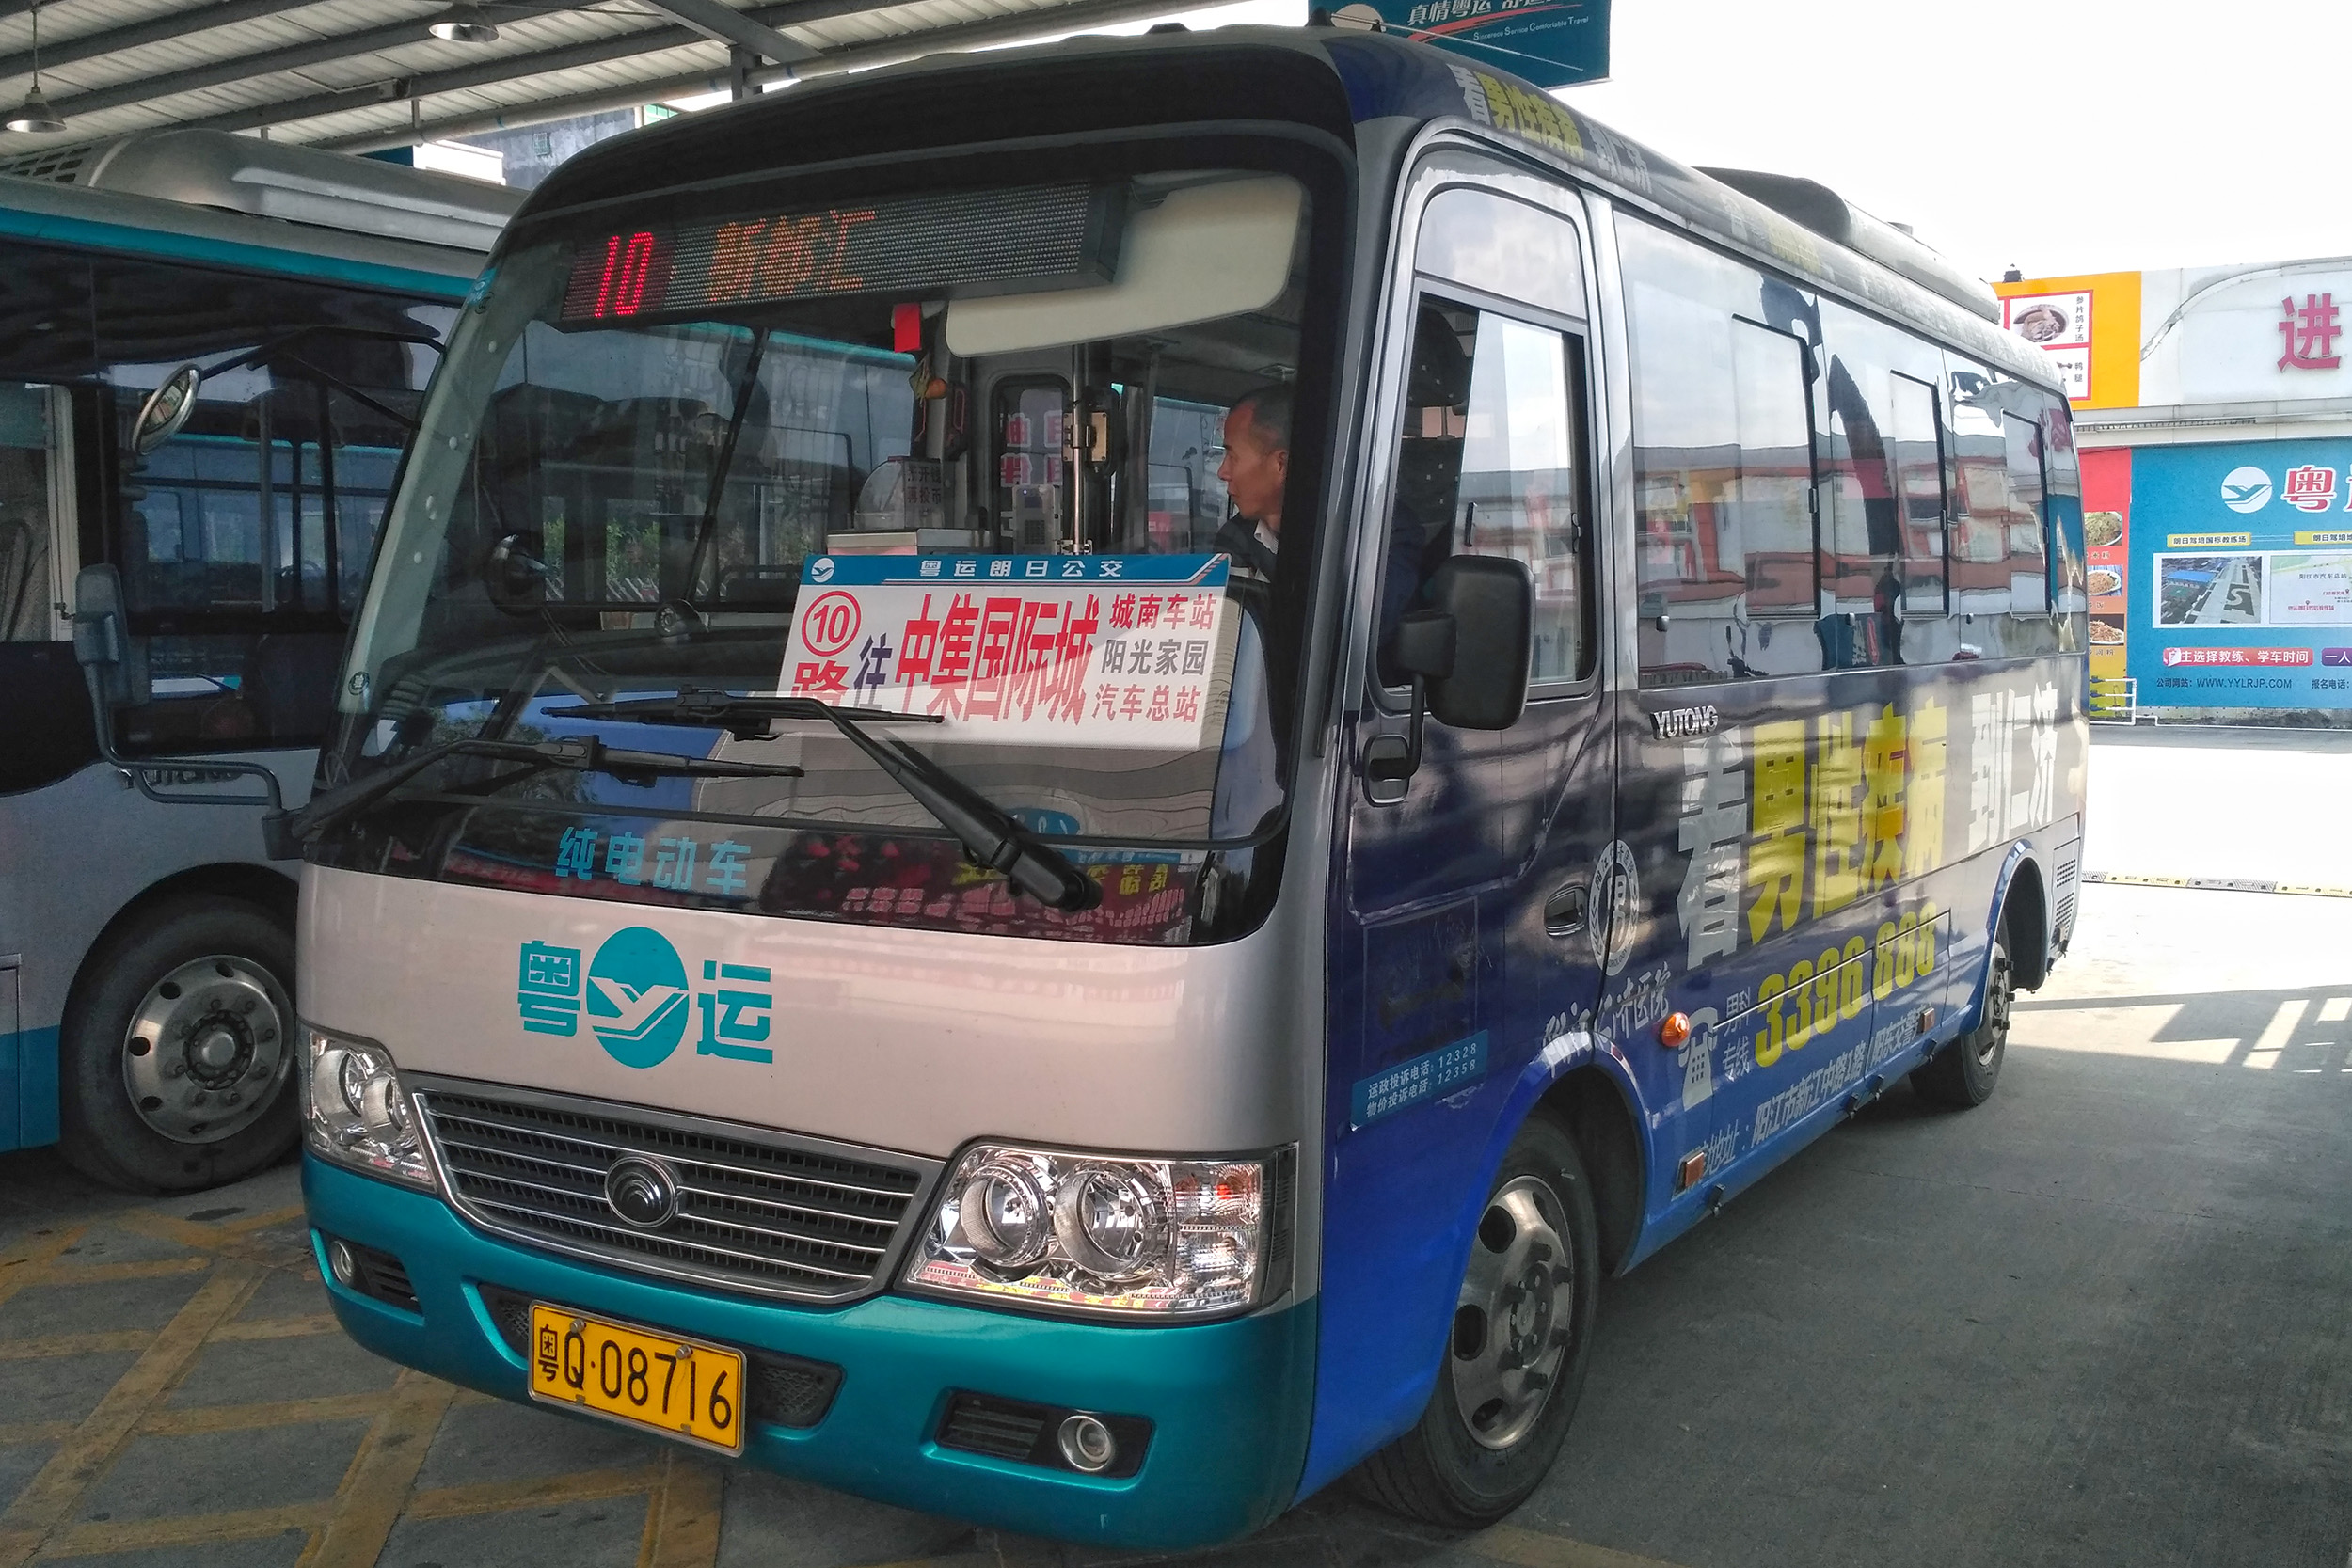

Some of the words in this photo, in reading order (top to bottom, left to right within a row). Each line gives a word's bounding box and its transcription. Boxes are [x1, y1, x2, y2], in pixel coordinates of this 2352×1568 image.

[1568, 16, 1589, 25] Travel
[594, 232, 654, 318] 10
[2277, 293, 2342, 373] 进
[2280, 465, 2352, 513] 粤
[919, 560, 1124, 578] 粤运朗日公交
[812, 605, 850, 643] 10
[1109, 593, 1216, 630] 城南车站
[895, 592, 1100, 725] 中集国际城
[1101, 639, 1209, 675] 阳光家园
[1091, 683, 1201, 722] 汽车总站
[1650, 705, 1719, 740] YUTONG
[555, 826, 751, 894] 纯电动车
[518, 941, 580, 1037] 粤
[696, 960, 773, 1064] 运
[1755, 936, 1866, 1068] 3396
[1438, 1058, 1476, 1085] 12358
[1439, 1042, 1476, 1069] 12328
